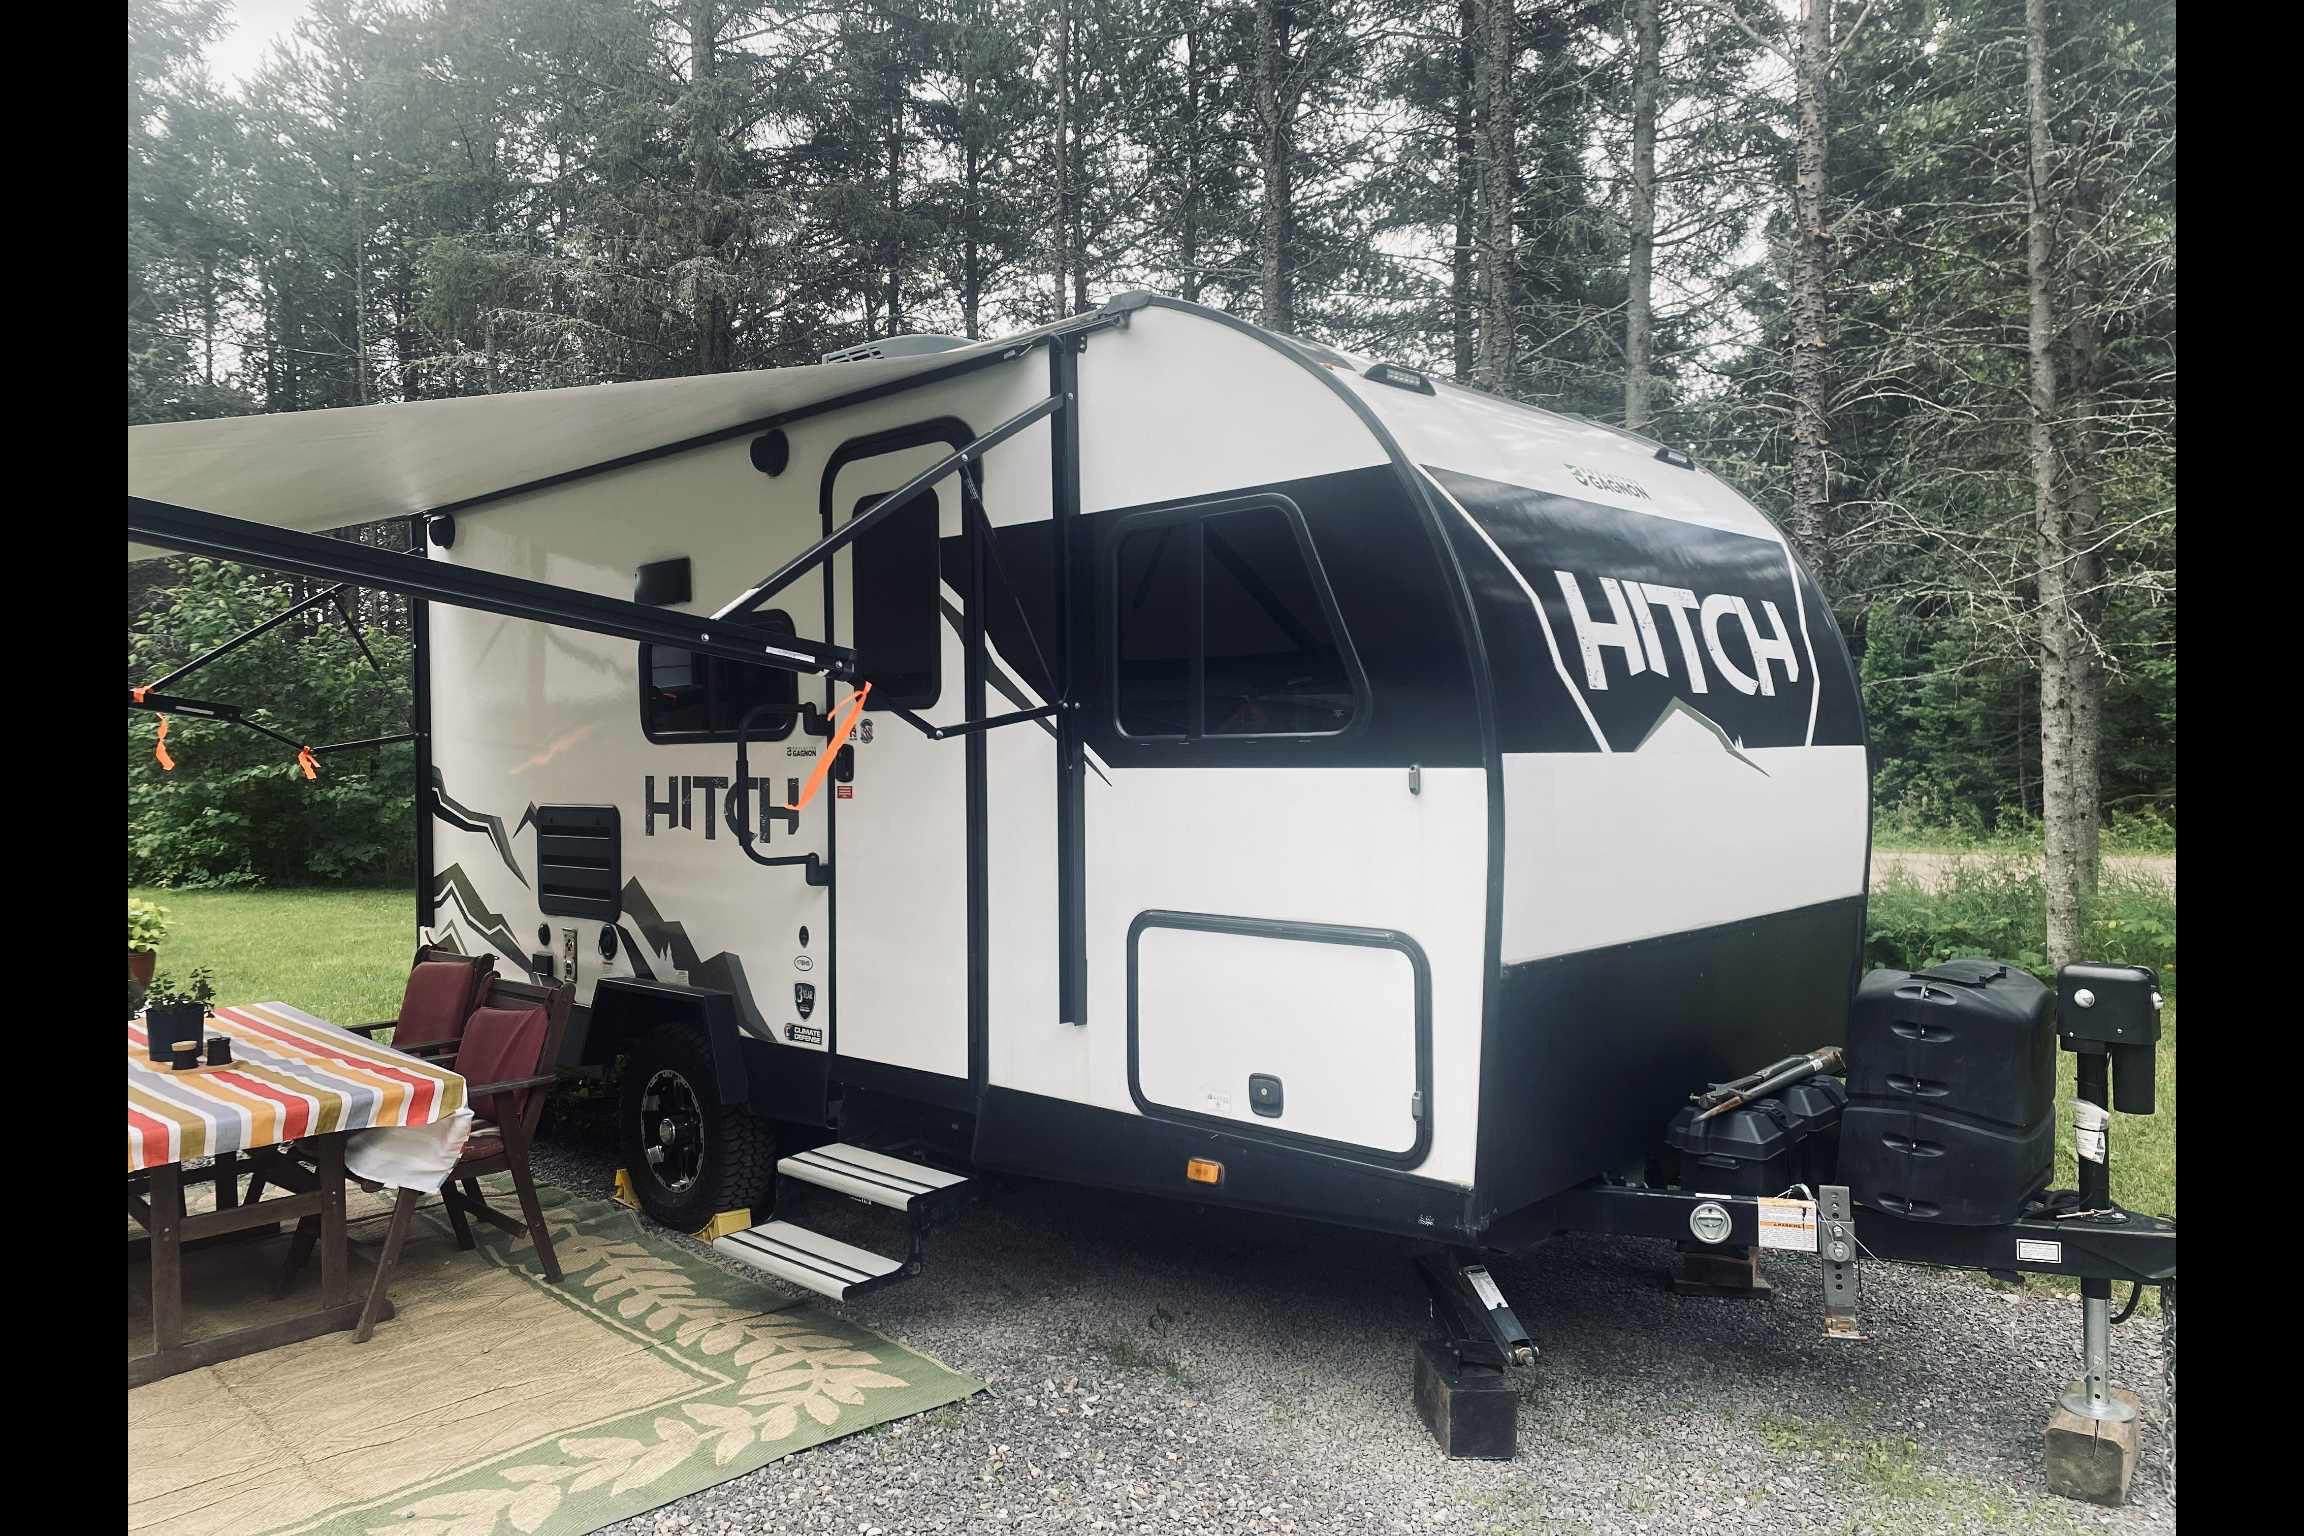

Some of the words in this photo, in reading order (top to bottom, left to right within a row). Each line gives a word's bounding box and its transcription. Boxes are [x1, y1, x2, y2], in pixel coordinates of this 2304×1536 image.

[1554, 570, 1799, 697] HITCH
[645, 775, 800, 843] HITCH
[794, 1026, 822, 1038] CLIMATE
[794, 1033, 822, 1044] DEFENSE
